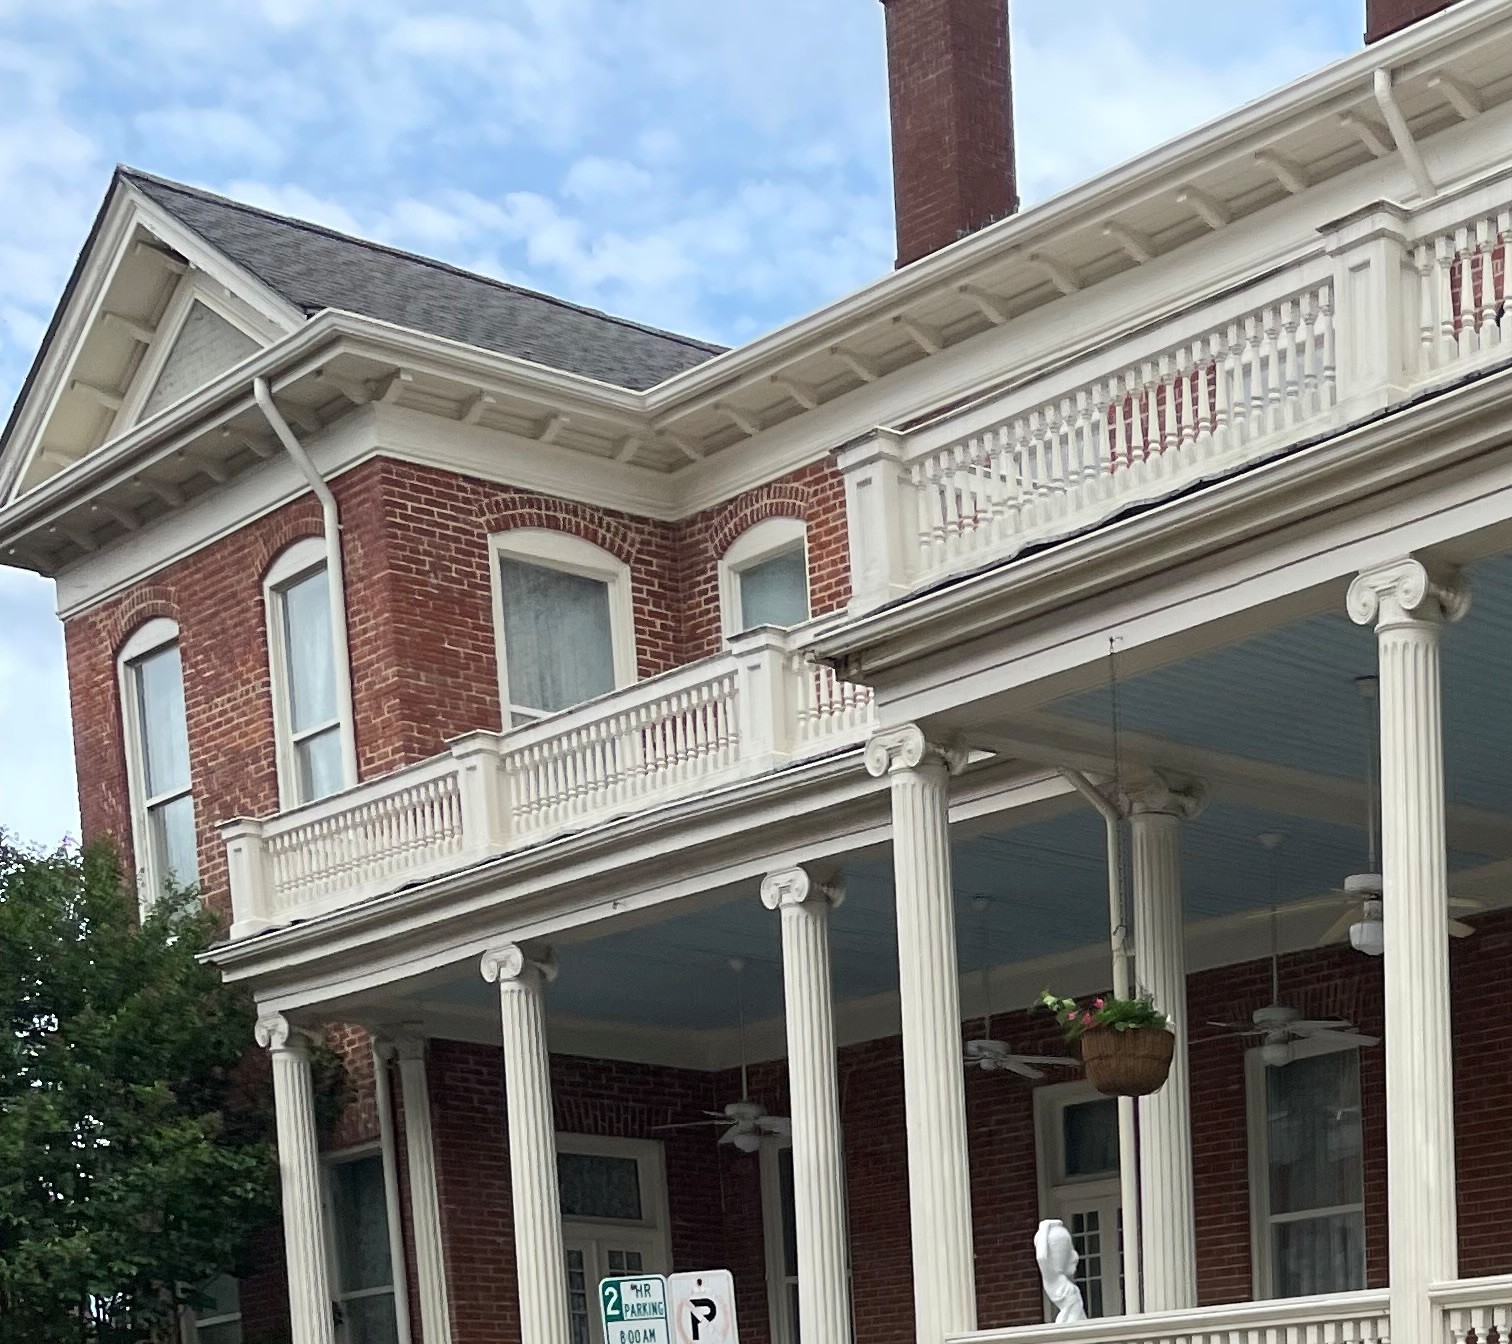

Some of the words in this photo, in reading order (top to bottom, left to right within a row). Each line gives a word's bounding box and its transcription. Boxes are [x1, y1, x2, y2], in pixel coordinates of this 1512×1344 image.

[604, 1286, 620, 1316] 2
[635, 1283, 652, 1299] HR
[624, 1301, 664, 1318] PARKING
[643, 1328, 657, 1343] AM
